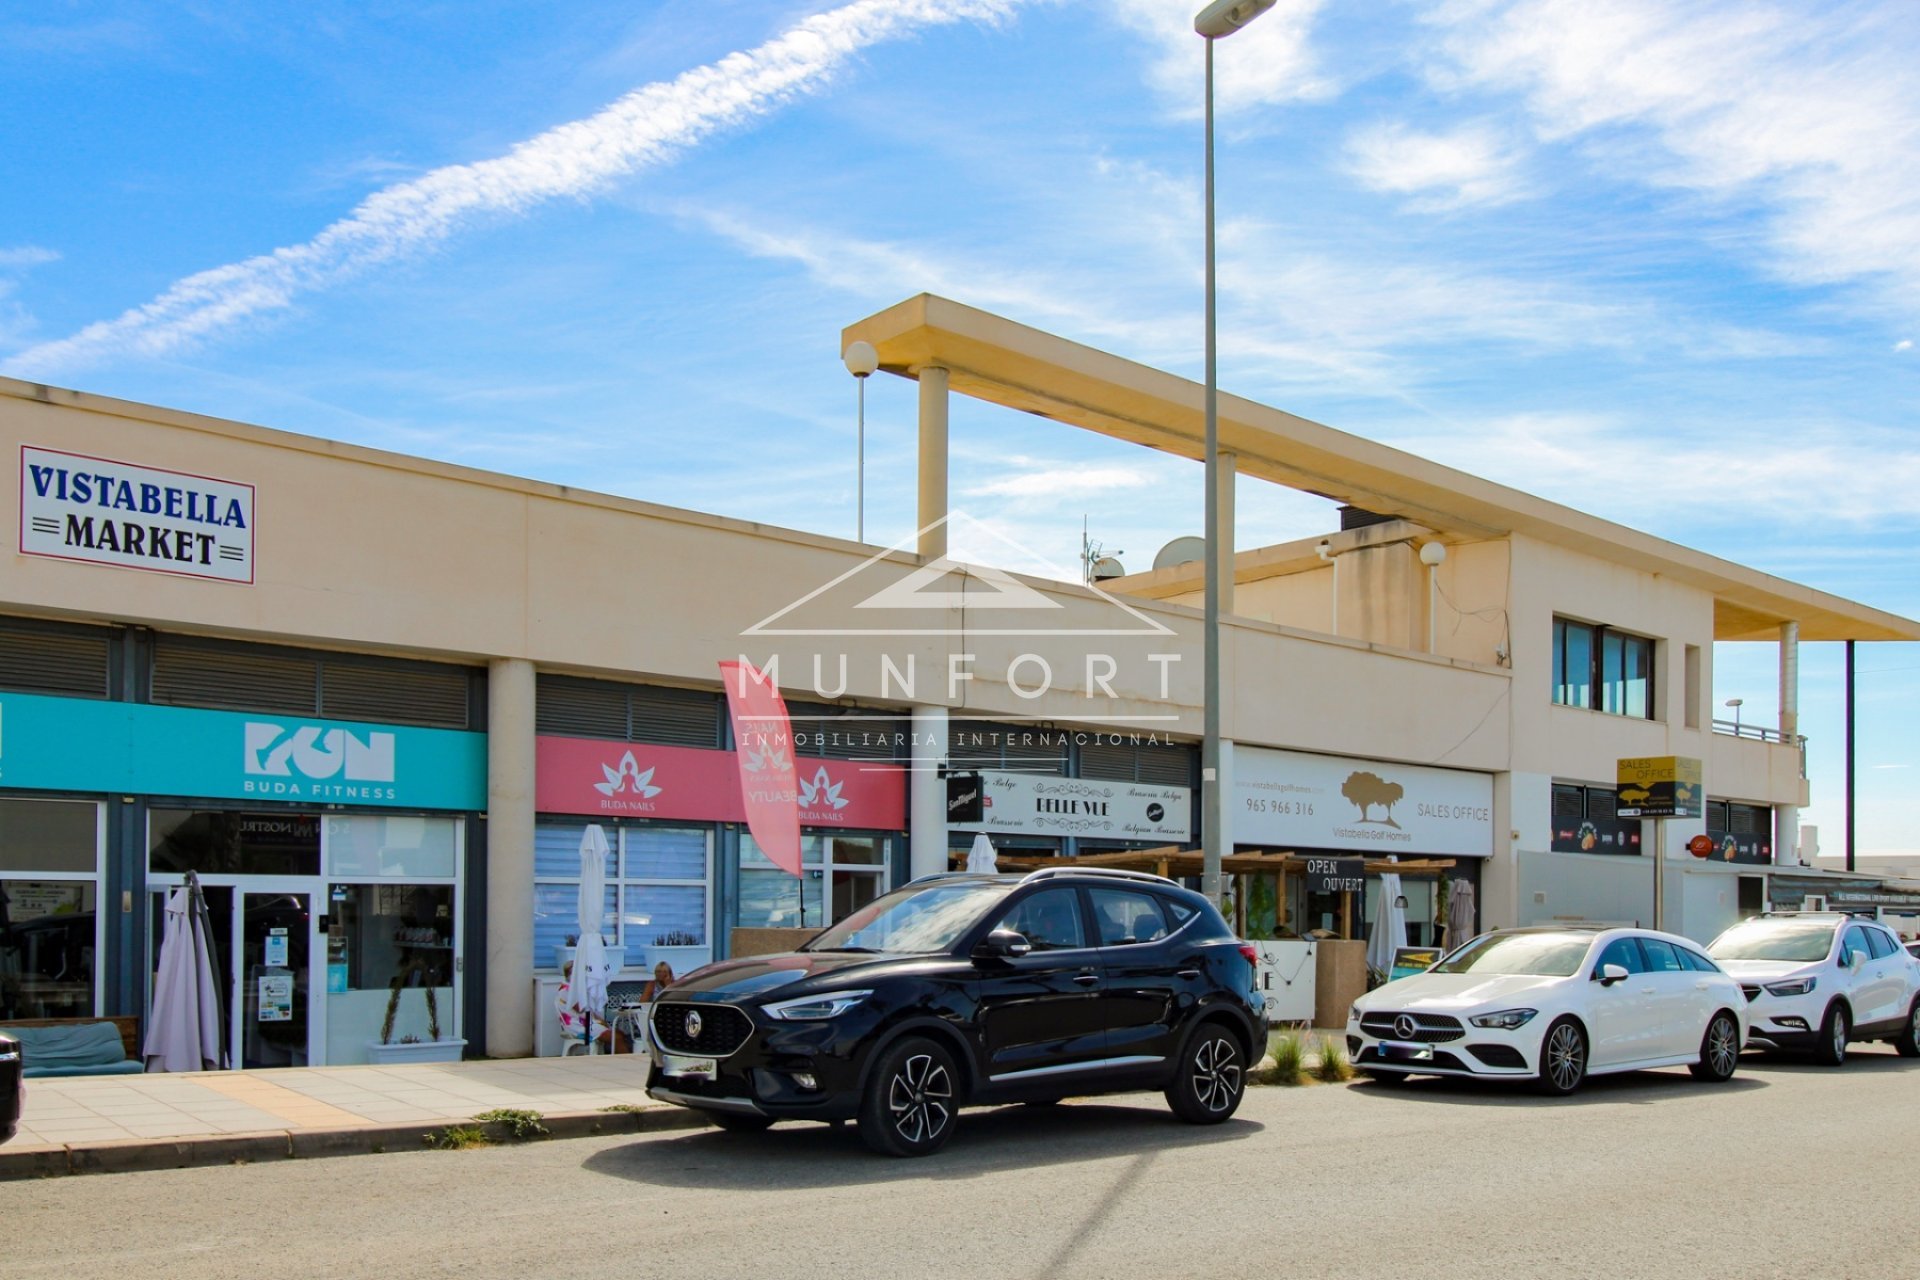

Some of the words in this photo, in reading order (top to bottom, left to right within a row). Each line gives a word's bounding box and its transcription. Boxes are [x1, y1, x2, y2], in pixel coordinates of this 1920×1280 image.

[29, 464, 246, 529] VISTABELLA
[65, 514, 216, 565] MARKET
[1619, 760, 1651, 770] SALES
[1636, 768, 1674, 780] OFFICE
[244, 781, 300, 795] BUDA
[312, 784, 395, 799] FITNESS
[601, 799, 627, 810] BUDA
[629, 801, 656, 812] NAILS
[1037, 798, 1080, 815] BELLE
[1083, 800, 1110, 816] VUE
[1246, 798, 1266, 812] 965
[1271, 800, 1291, 814] 966
[1295, 801, 1314, 816] 316
[1417, 803, 1450, 818] SALES
[1453, 805, 1489, 821] OFFICE
[798, 811, 819, 820] BUDA
[820, 812, 844, 821] NAILS
[1333, 827, 1370, 840] Vistabella
[1371, 830, 1385, 841] Golf
[1386, 831, 1412, 842] Homes
[1307, 859, 1338, 874] OPEN
[1323, 877, 1364, 892] OUVERT
